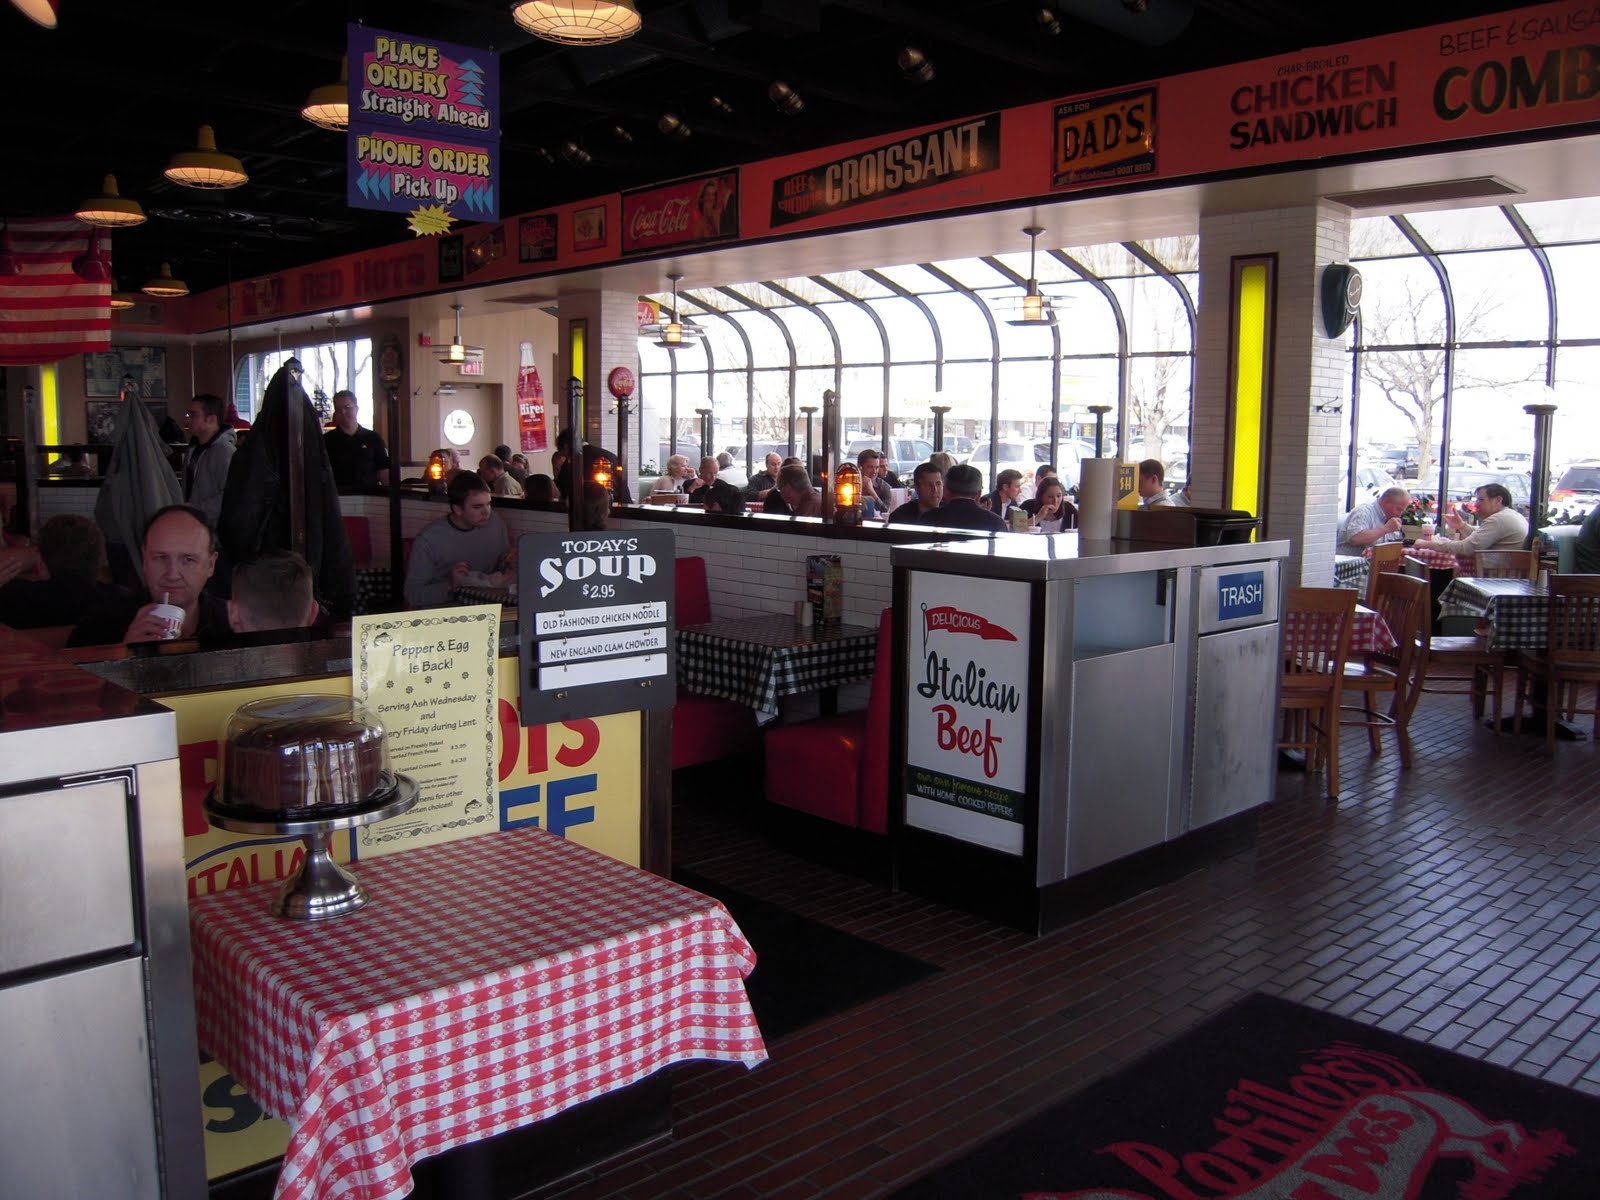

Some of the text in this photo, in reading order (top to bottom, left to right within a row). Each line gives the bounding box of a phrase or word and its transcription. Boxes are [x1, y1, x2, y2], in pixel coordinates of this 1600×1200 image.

[375, 36, 440, 70] PLACE
[1439, 25, 1501, 56] BEEF
[367, 61, 449, 99] ORDERS
[1230, 60, 1396, 115] CHICKEN
[360, 89, 491, 129] Straight Ahead
[1058, 102, 1090, 115] ASK FOR
[1064, 104, 1144, 162] DAD'S
[1230, 97, 1397, 150] SANDWICH
[357, 135, 491, 178] PHONE ORDER
[825, 120, 986, 206] CROISSANT
[1134, 162, 1152, 173] BEER
[393, 173, 459, 206] Pick Up
[520, 403, 545, 416] Hires
[561, 538, 638, 554] TODAY'S
[539, 554, 657, 599] SOUP
[582, 583, 616, 599] $2.95
[1221, 583, 1262, 607] TRASH
[543, 609, 660, 630] OLD FASHIONED CHICKEN NOODLE
[931, 611, 981, 631] DELICIOUS
[392, 639, 470, 659] Pepper & Egg
[550, 638, 659, 660] NEW ENGLAND CLAM CHOWDER
[409, 658, 454, 674] Is Back!
[917, 650, 1020, 714] Italian
[378, 694, 477, 713] Serving Ash Wednesday
[420, 711, 436, 720] and
[387, 718, 477, 739] ery Friday during Lent
[931, 704, 1002, 779] Beef
[917, 783, 1014, 818] WITH HOME COOKED PEPPERS
